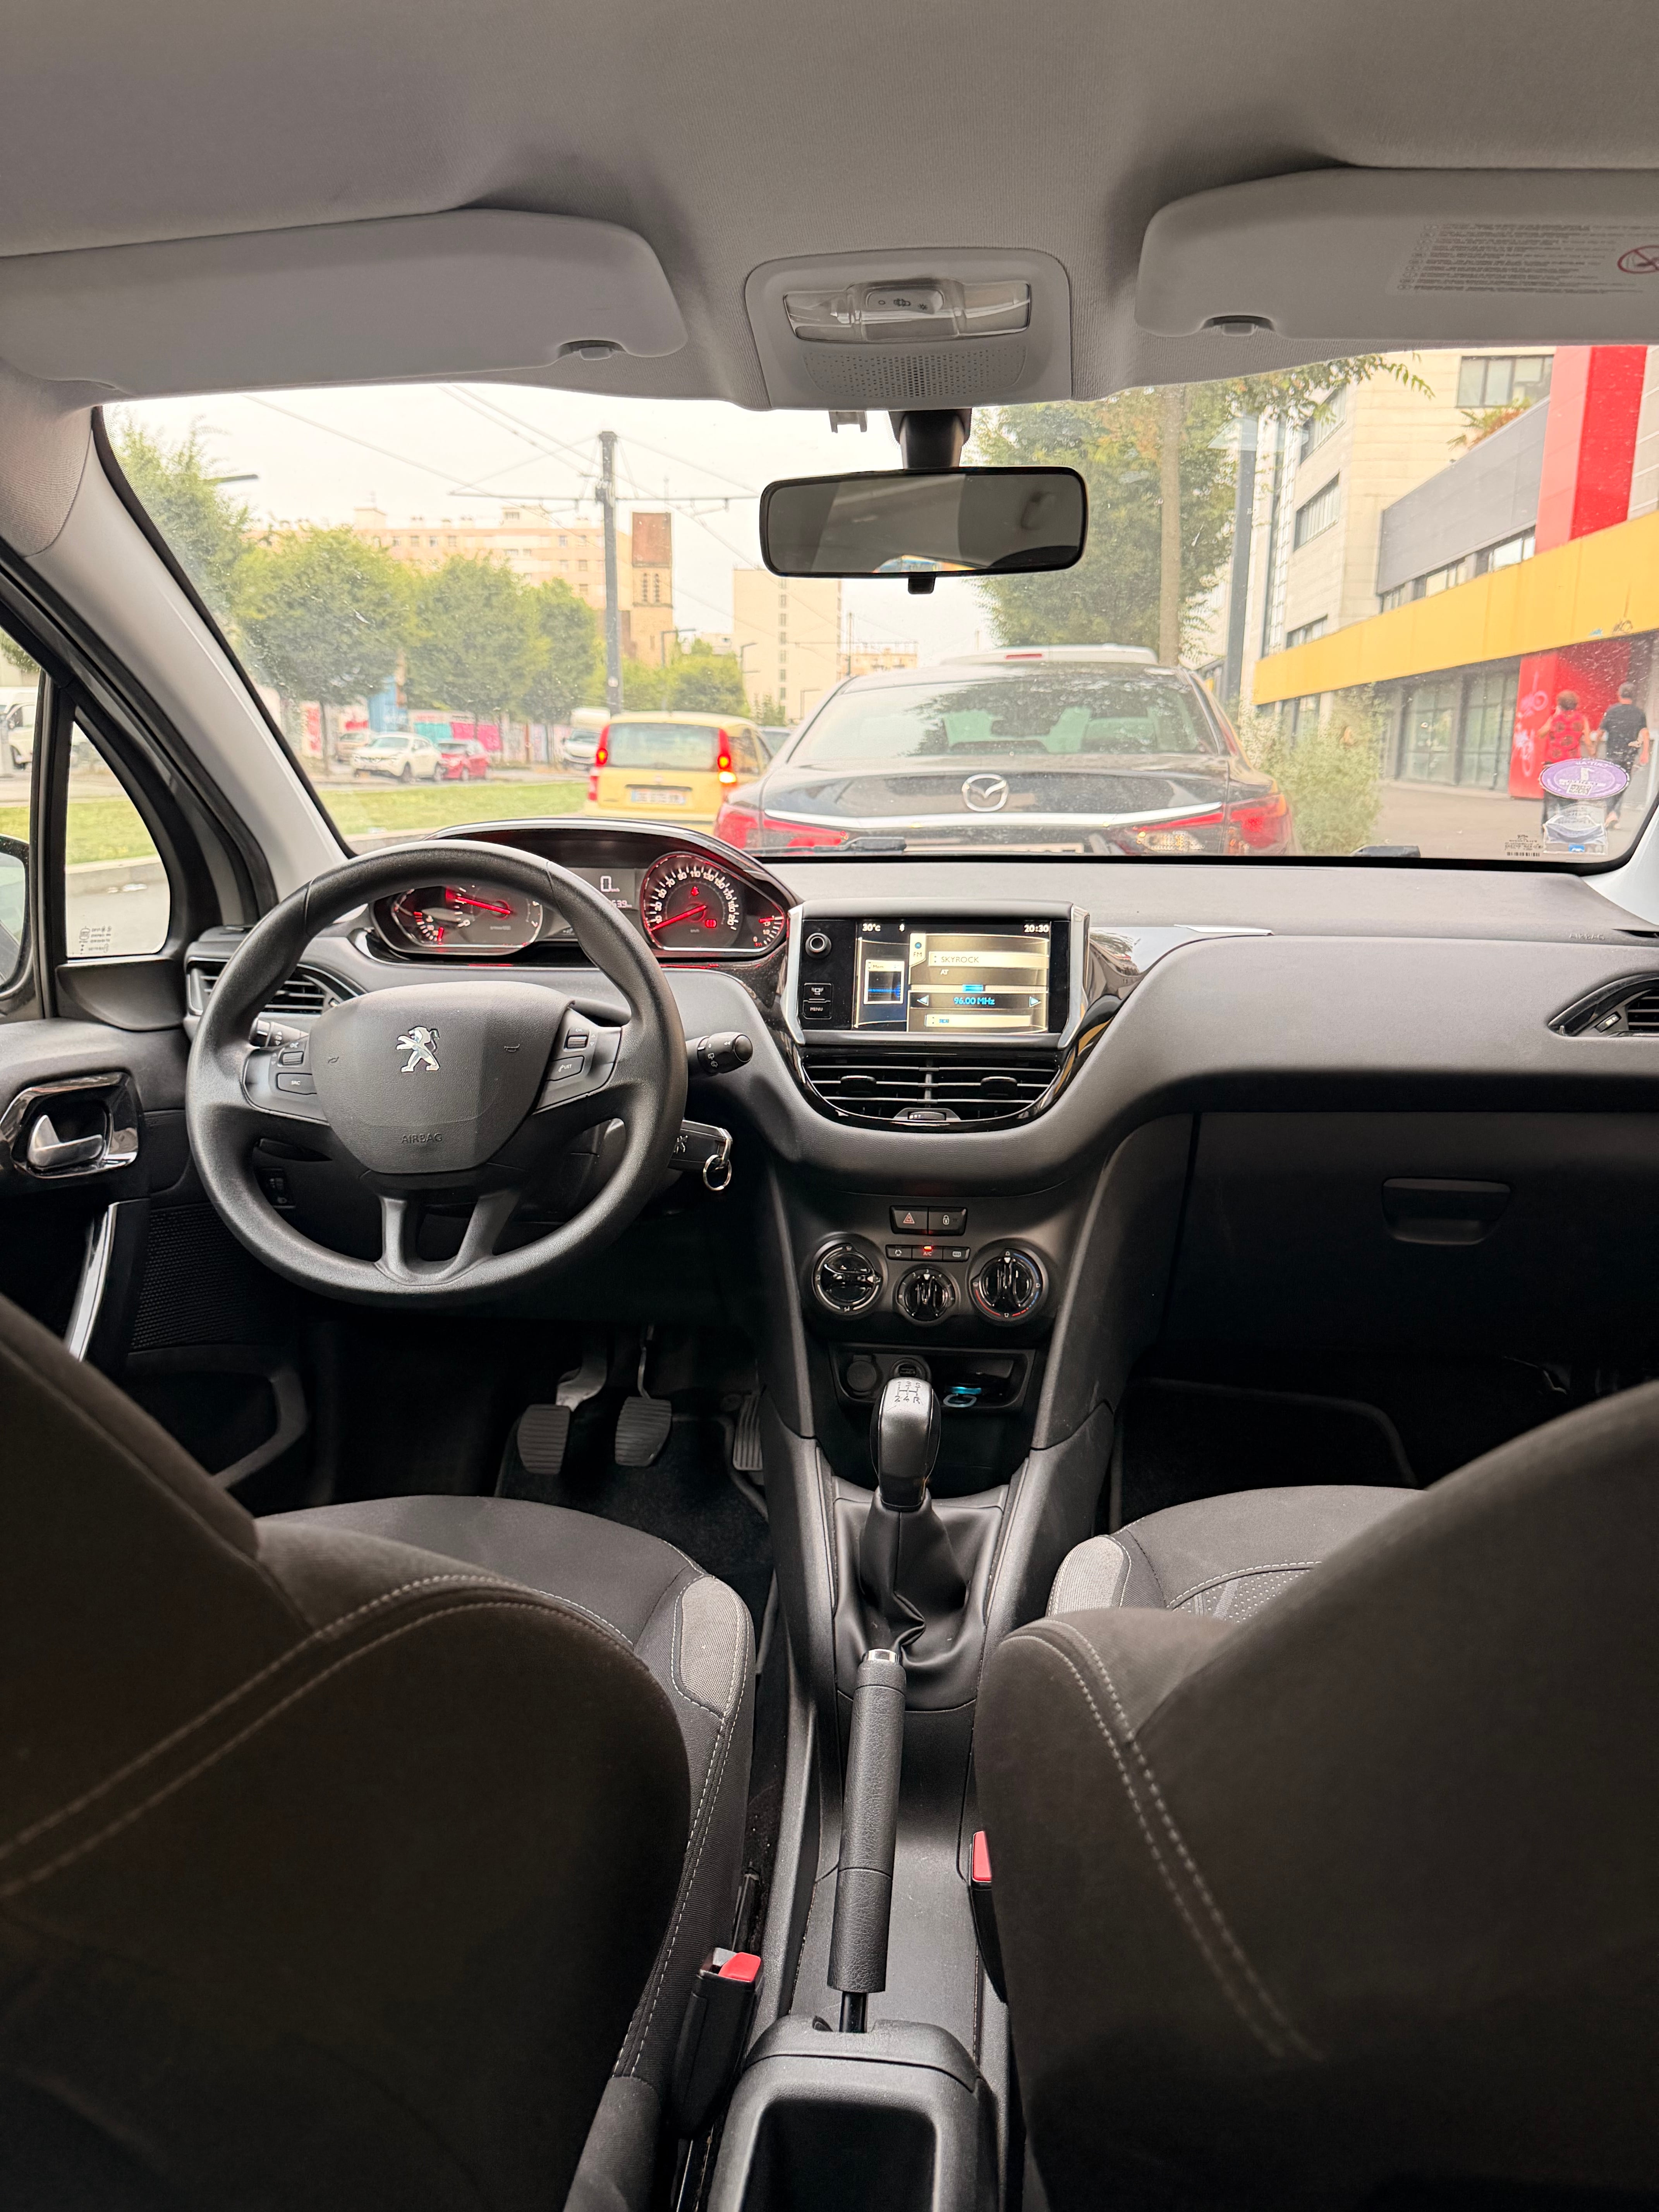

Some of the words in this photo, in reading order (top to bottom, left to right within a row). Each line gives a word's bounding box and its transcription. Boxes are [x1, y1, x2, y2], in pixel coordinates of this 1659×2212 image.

[601, 876, 611, 892] 0
[1024, 924, 1049, 933] 20:30
[402, 1133, 442, 1144] AIRBAG
